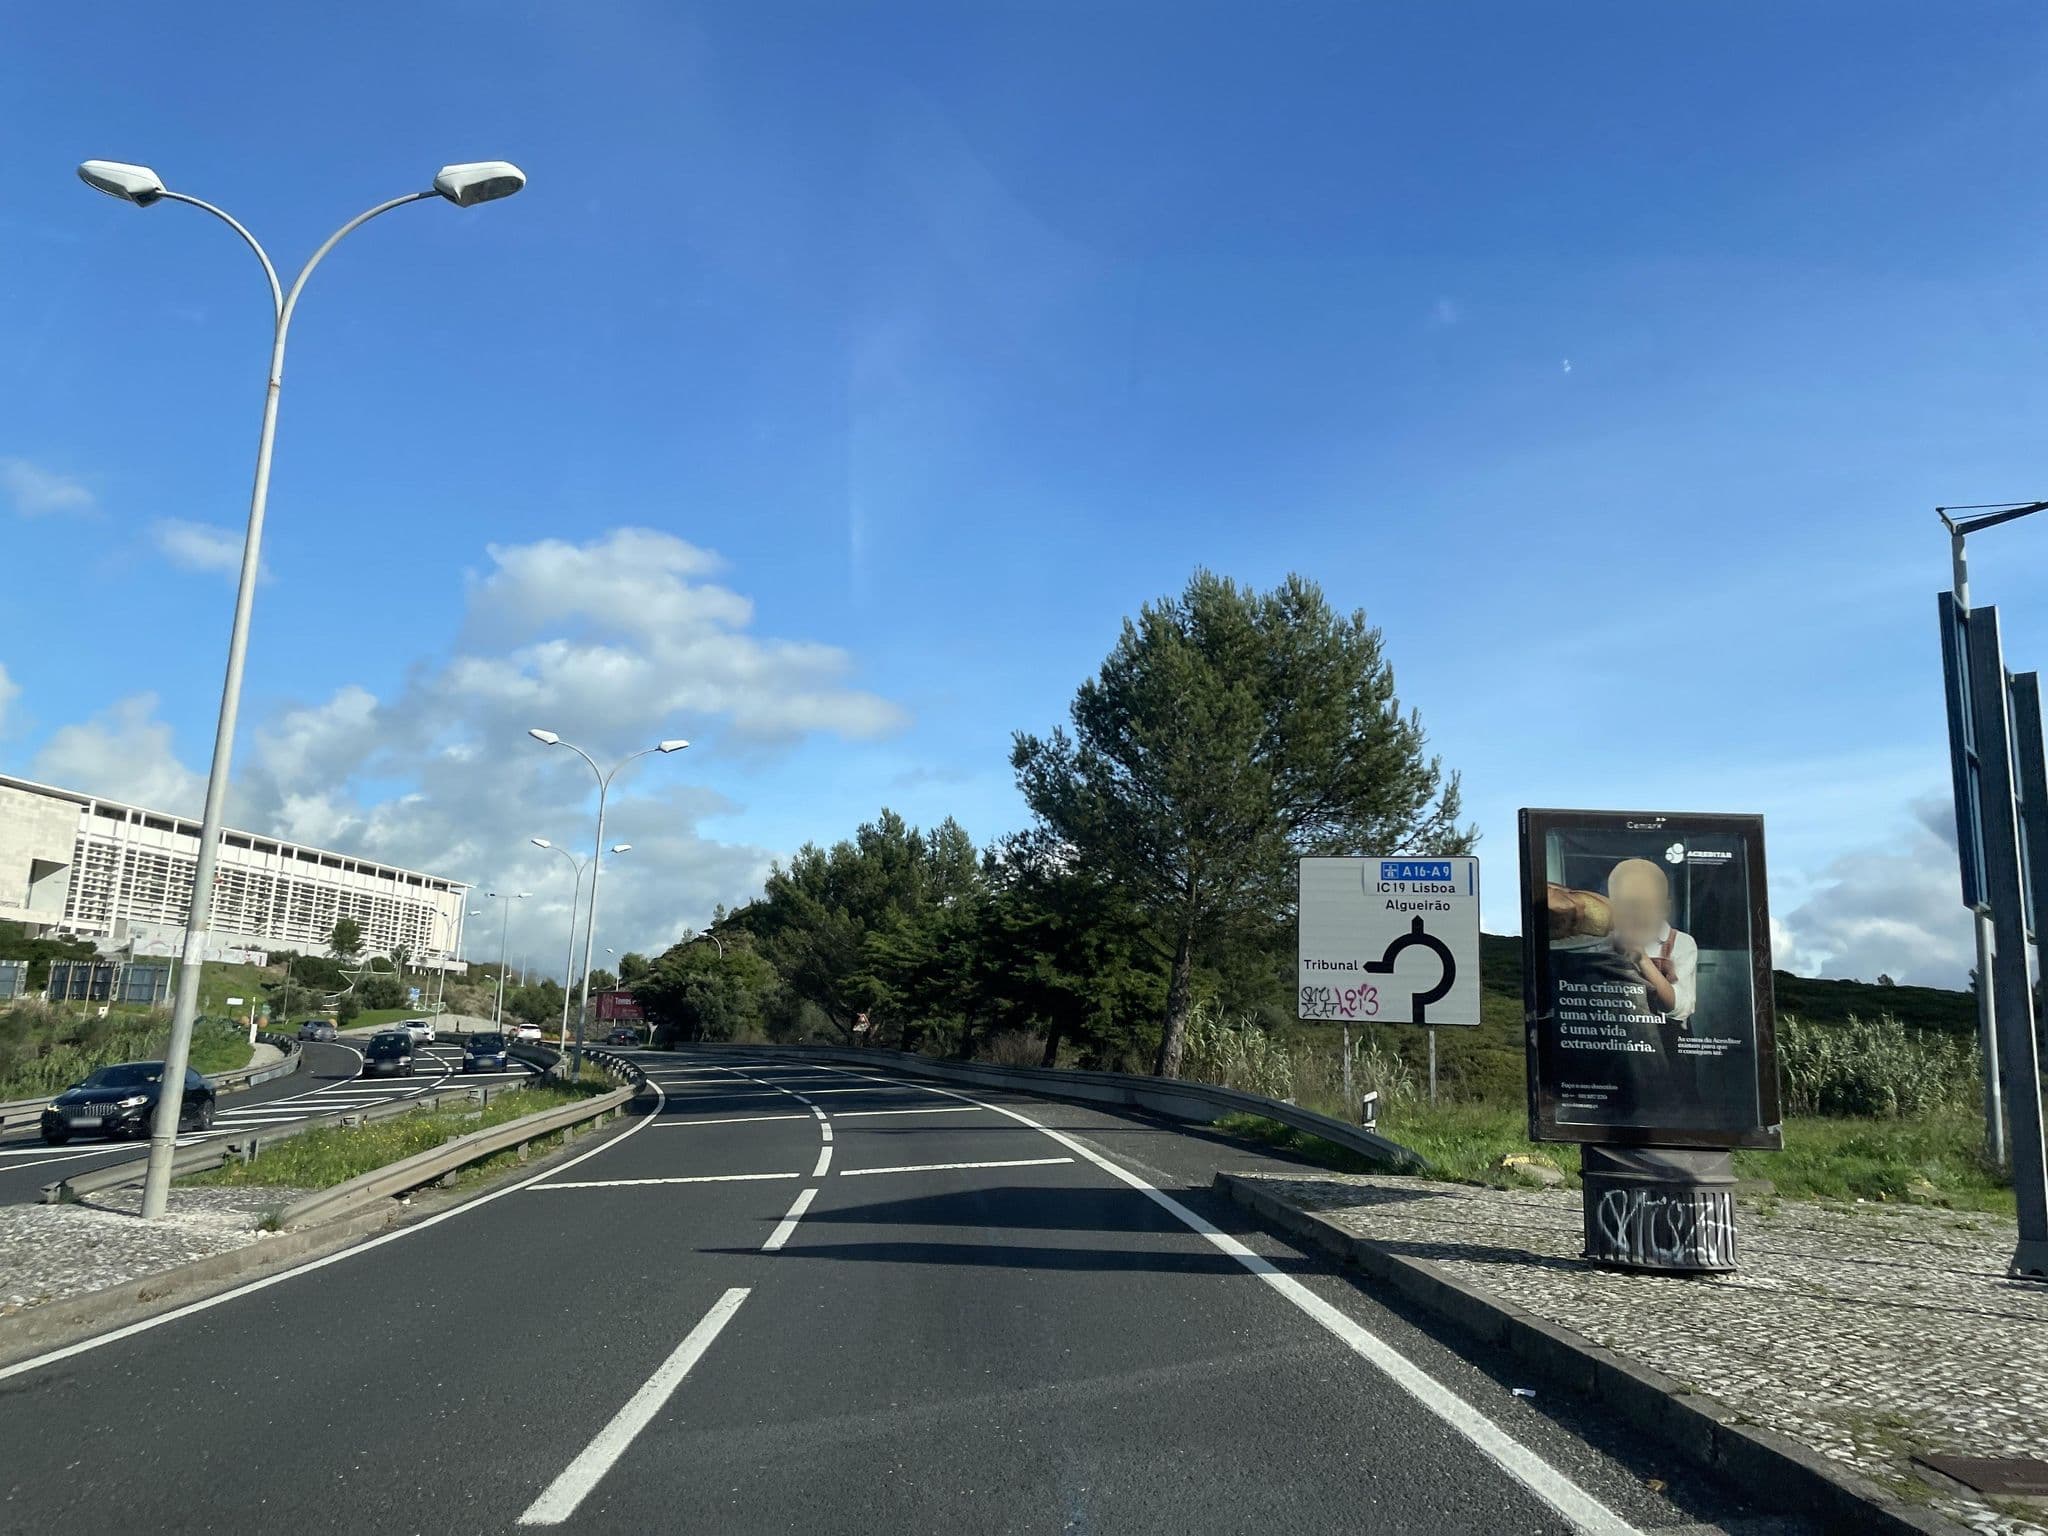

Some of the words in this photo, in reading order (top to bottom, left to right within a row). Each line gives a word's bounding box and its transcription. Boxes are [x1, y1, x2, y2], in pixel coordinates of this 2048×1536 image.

[1686, 850, 1733, 859] ACREDITAR
[1412, 882, 1456, 894] Lisboa
[1385, 899, 1451, 912] Algueirão
[1303, 959, 1359, 971] Tribunal
[1558, 979, 1588, 992] Para
[1590, 982, 1645, 997] crianças
[1558, 997, 1587, 1006] com
[1589, 998, 1637, 1010] cancro,
[1559, 1011, 1588, 1021] uma
[1588, 1010, 1616, 1022] vida
[1618, 1012, 1667, 1025] normal
[1560, 1022, 1568, 1034] é
[1569, 1026, 1598, 1036] uma
[1599, 1025, 1627, 1037] vida
[1560, 1038, 1657, 1053] extraordinária.
